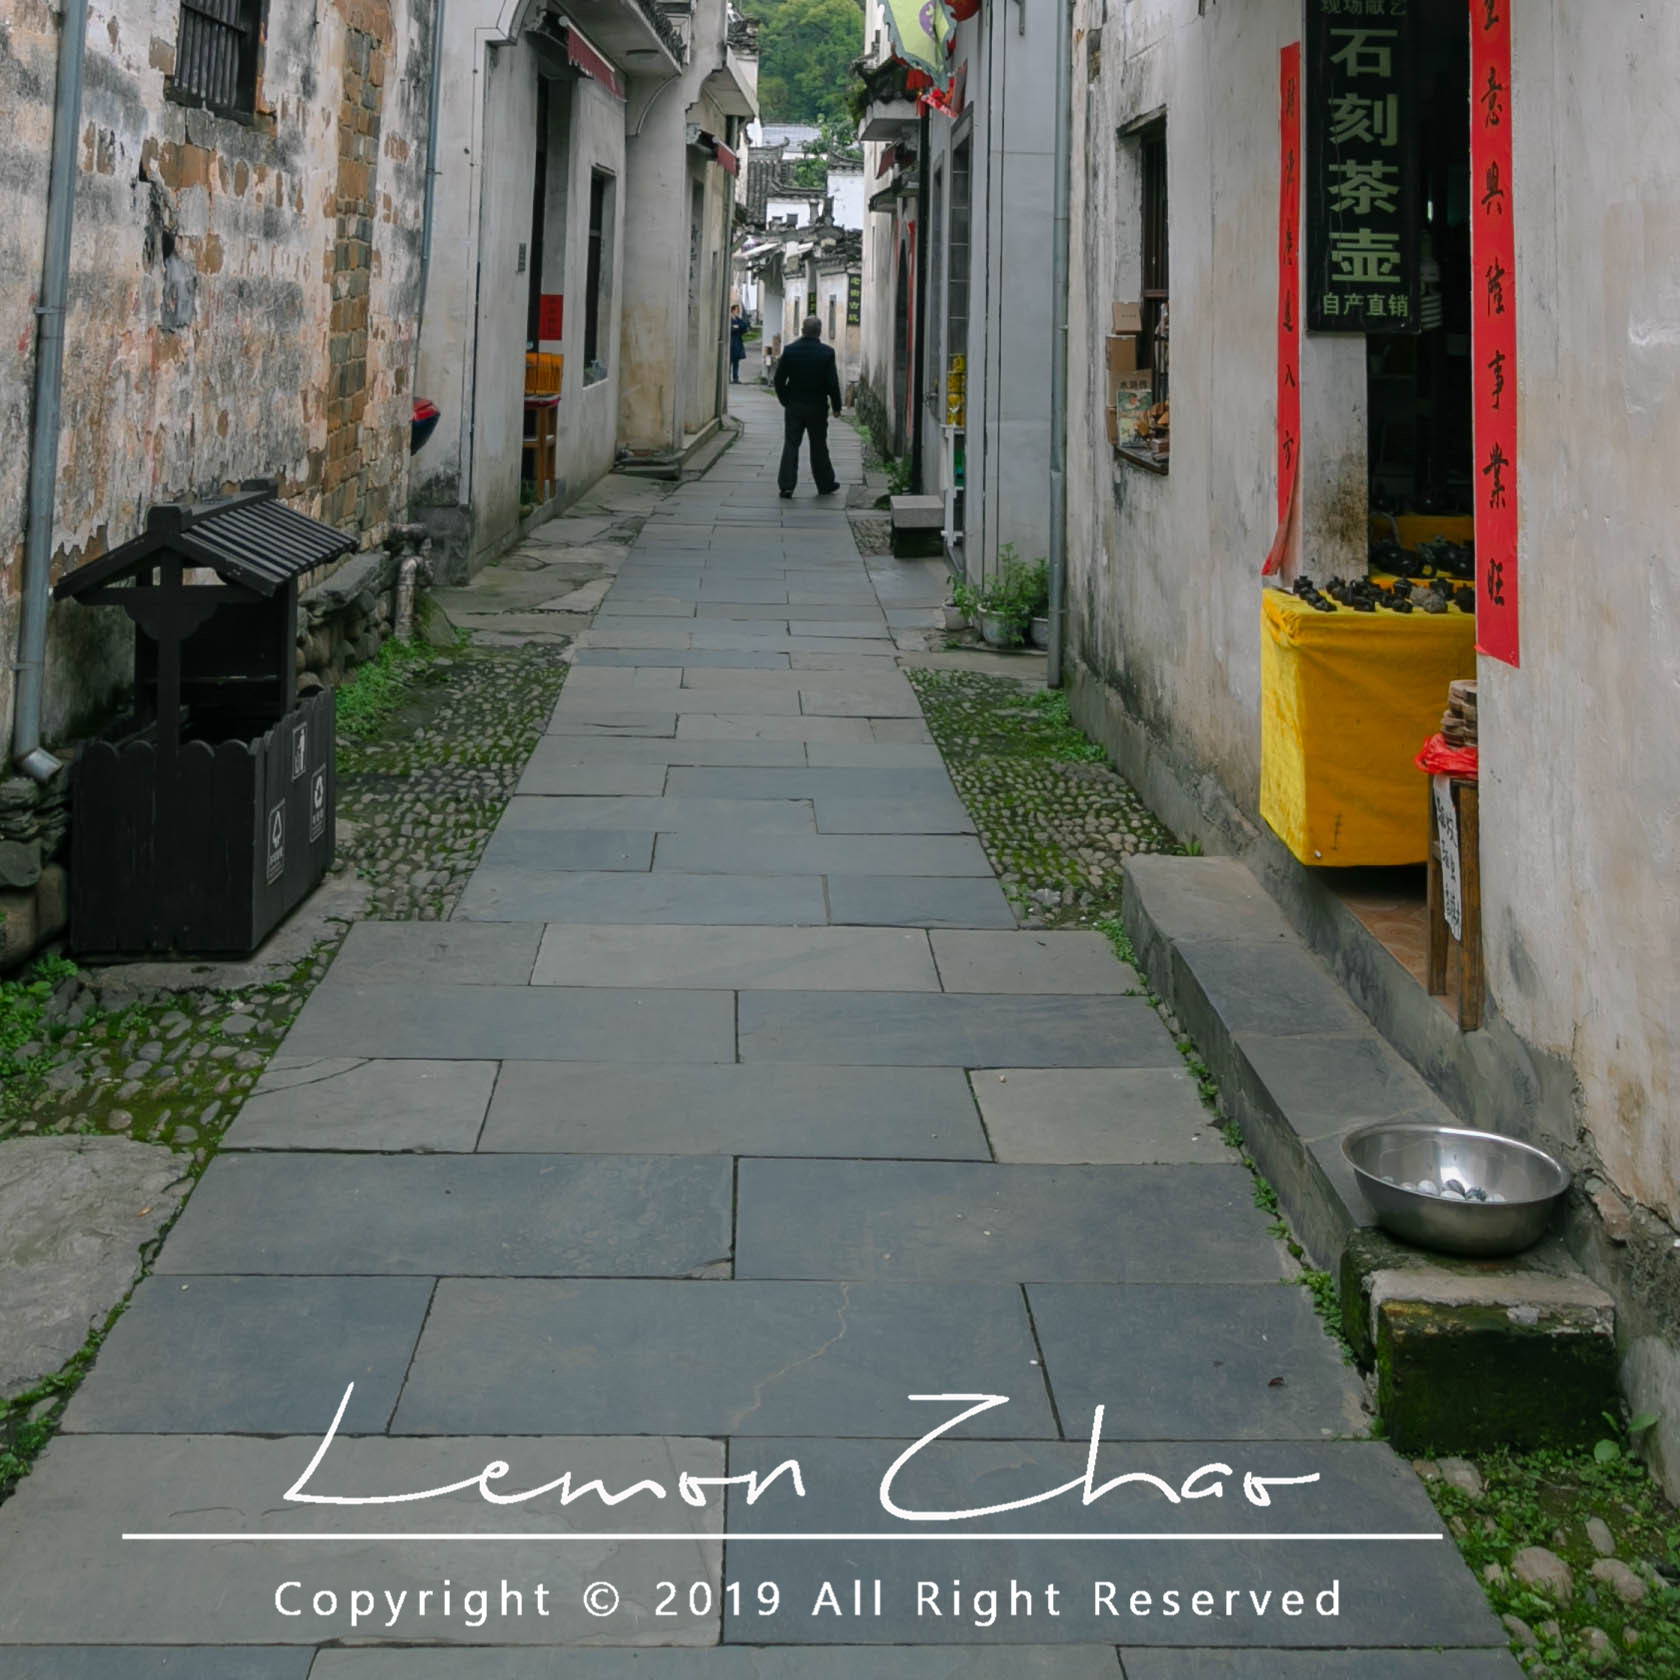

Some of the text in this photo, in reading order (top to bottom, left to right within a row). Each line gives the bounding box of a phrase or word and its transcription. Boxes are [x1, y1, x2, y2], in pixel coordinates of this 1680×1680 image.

[1327, 27, 1401, 283] 石刻茶壶
[1322, 291, 1409, 318] 自产直销
